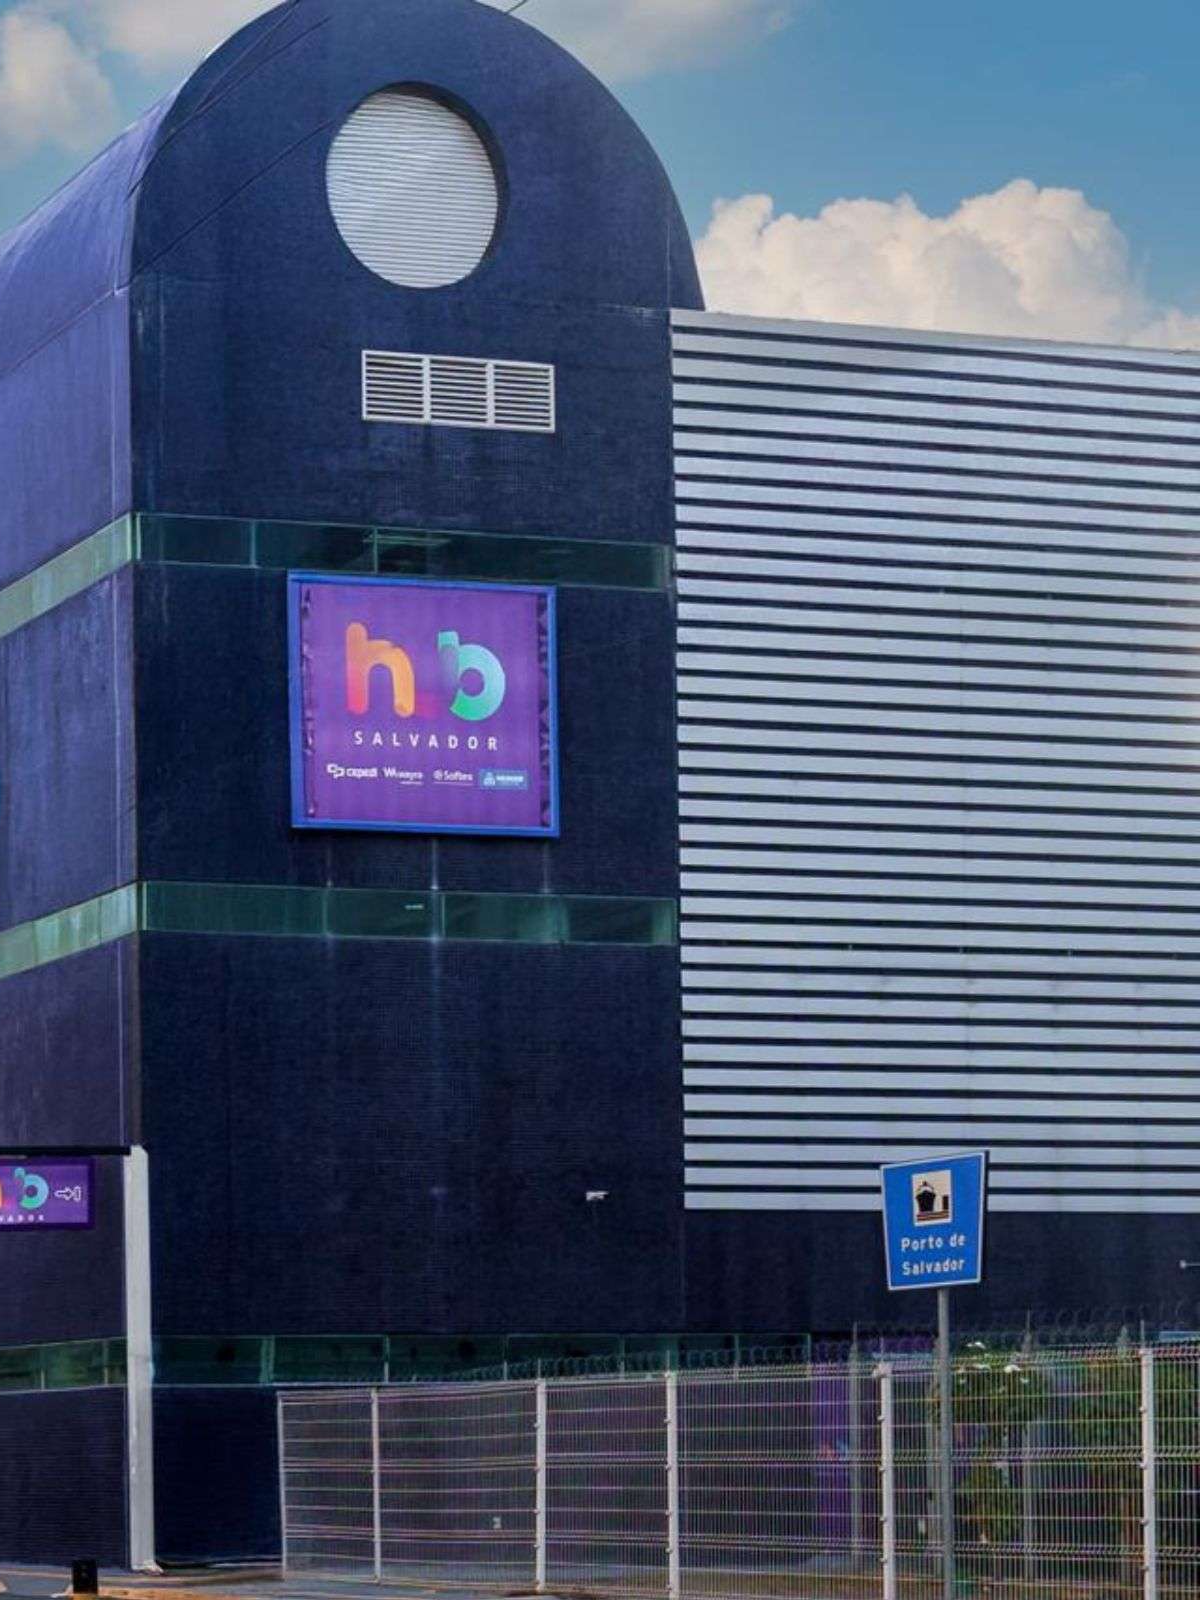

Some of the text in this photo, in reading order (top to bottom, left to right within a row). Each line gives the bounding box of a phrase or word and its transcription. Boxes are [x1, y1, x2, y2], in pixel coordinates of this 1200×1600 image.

[346, 622, 506, 721] hb
[353, 731, 497, 751] SALVADOR
[901, 1233, 966, 1252] Porto de
[902, 1258, 965, 1276] Salvador
